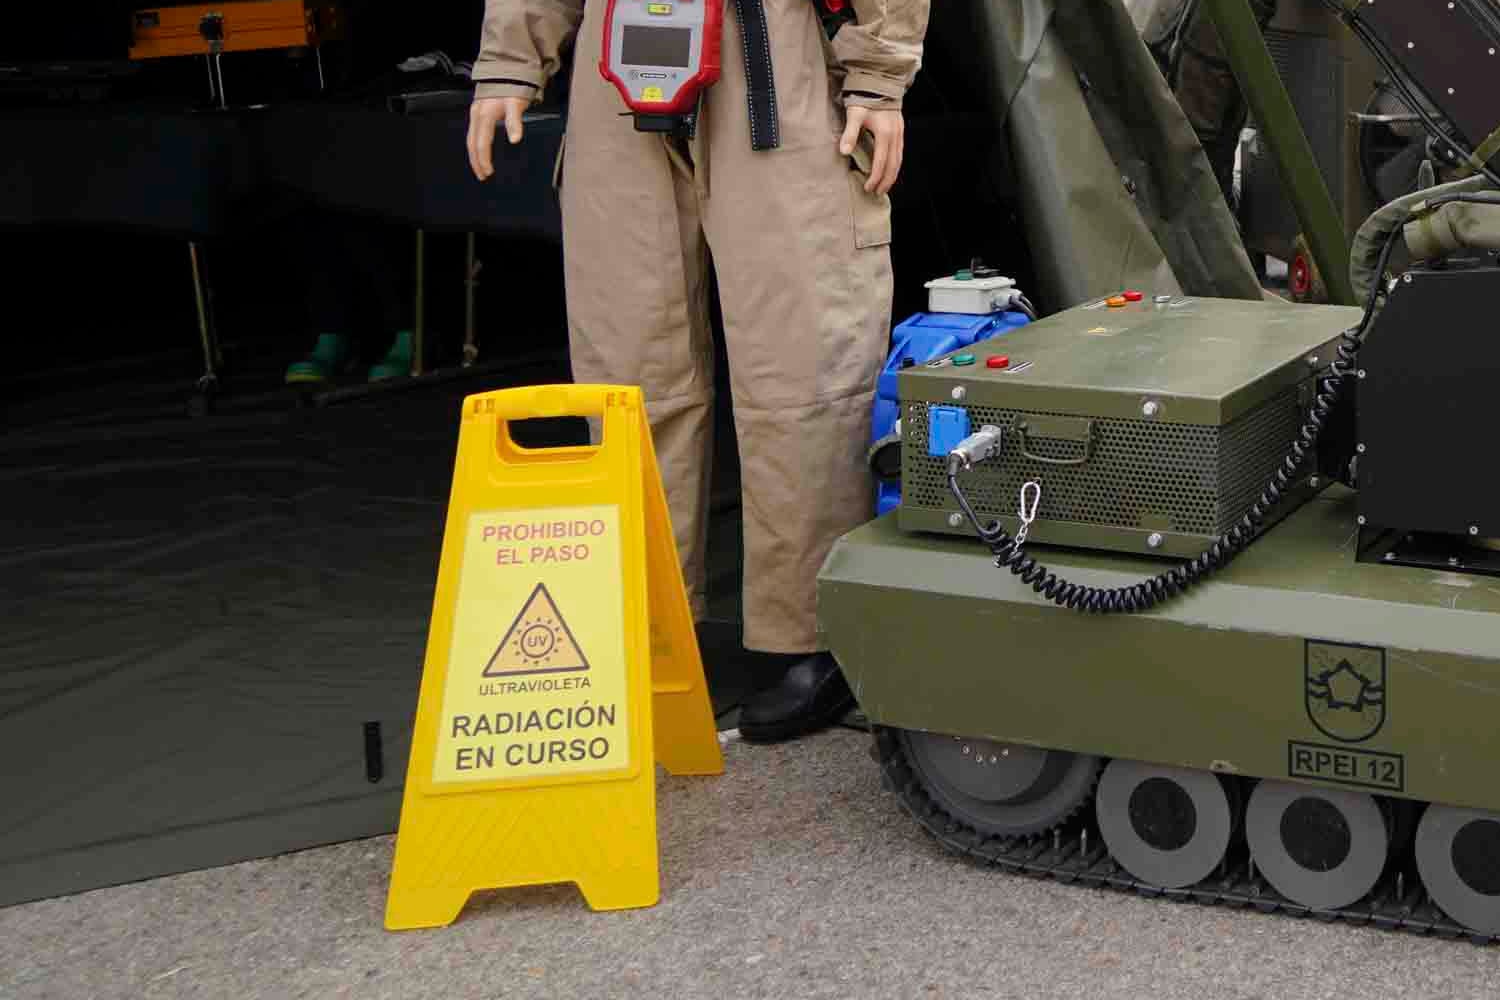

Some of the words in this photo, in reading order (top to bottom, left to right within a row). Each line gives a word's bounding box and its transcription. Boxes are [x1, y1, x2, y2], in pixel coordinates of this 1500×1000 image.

[482, 519, 606, 542] PROHIBIDO
[497, 548, 523, 565] EL
[529, 543, 590, 563] PASO
[527, 634, 549, 648] UV
[479, 676, 592, 697] ULTRAVIOLETA
[451, 699, 616, 738] RADIACIÓN
[455, 746, 495, 770] EN
[504, 736, 610, 766] CURSO
[1296, 751, 1358, 777] RPEI
[1367, 760, 1397, 783] 12
